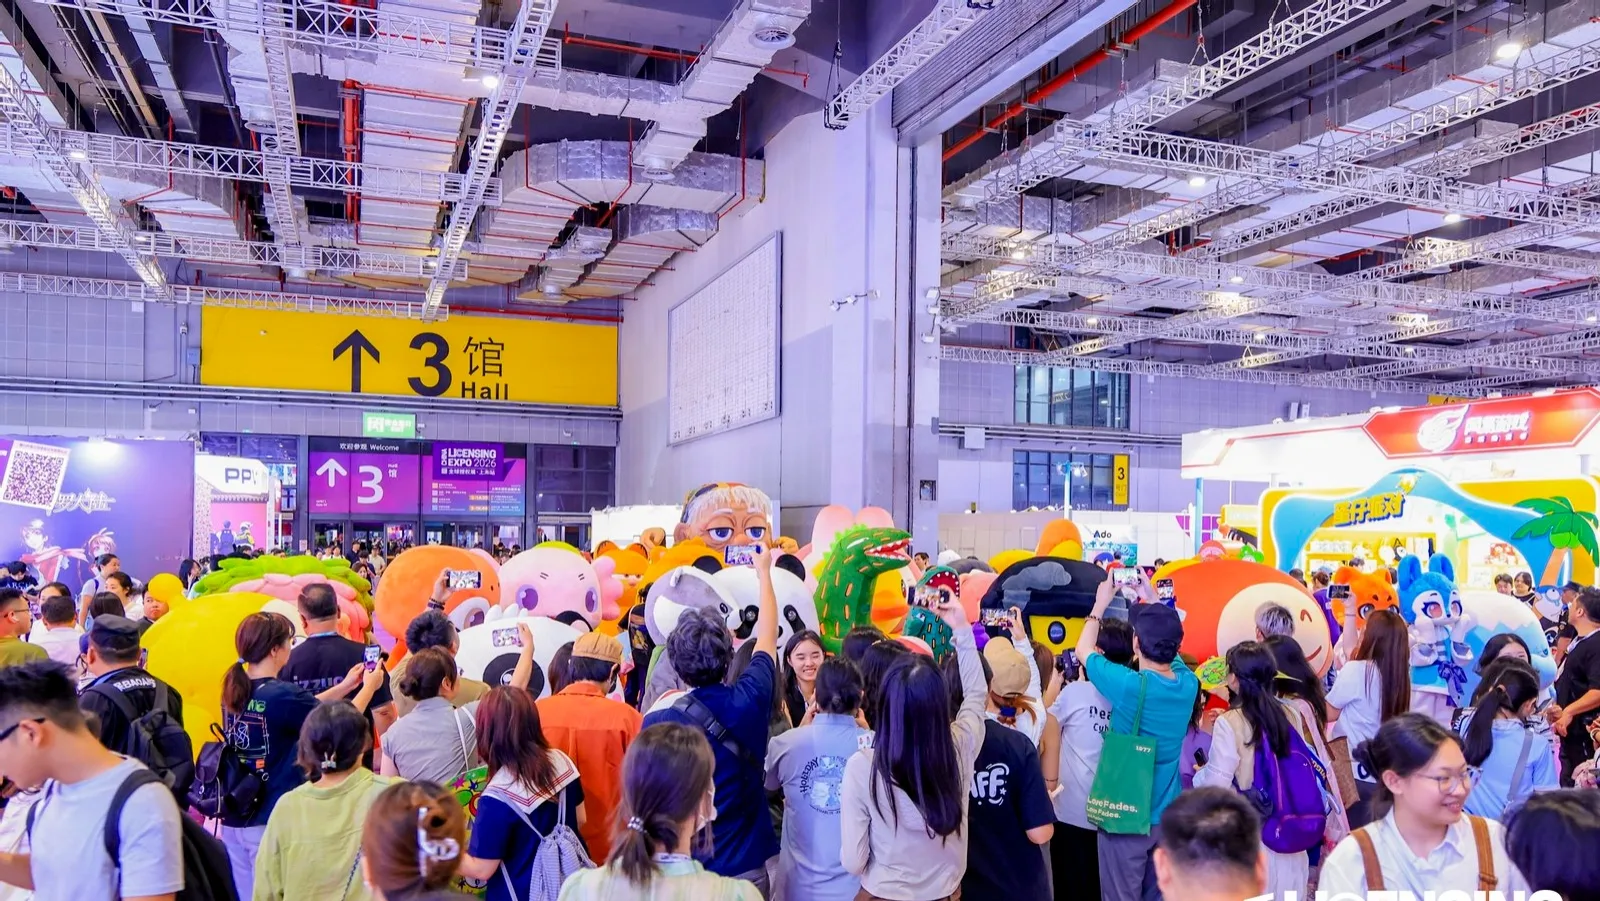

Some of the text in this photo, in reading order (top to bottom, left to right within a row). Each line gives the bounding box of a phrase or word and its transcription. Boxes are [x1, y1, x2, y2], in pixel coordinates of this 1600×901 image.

[408, 332, 504, 397] 3 馆
[461, 381, 508, 400] Hall
[370, 444, 399, 452] Welcome
[448, 448, 497, 459] LICENSING
[448, 458, 497, 468] EXPO 2026
[1117, 466, 1125, 480] 3
[357, 465, 384, 505] 3
[1093, 529, 1112, 539] Ado
[1103, 800, 1138, 813] Fades.
